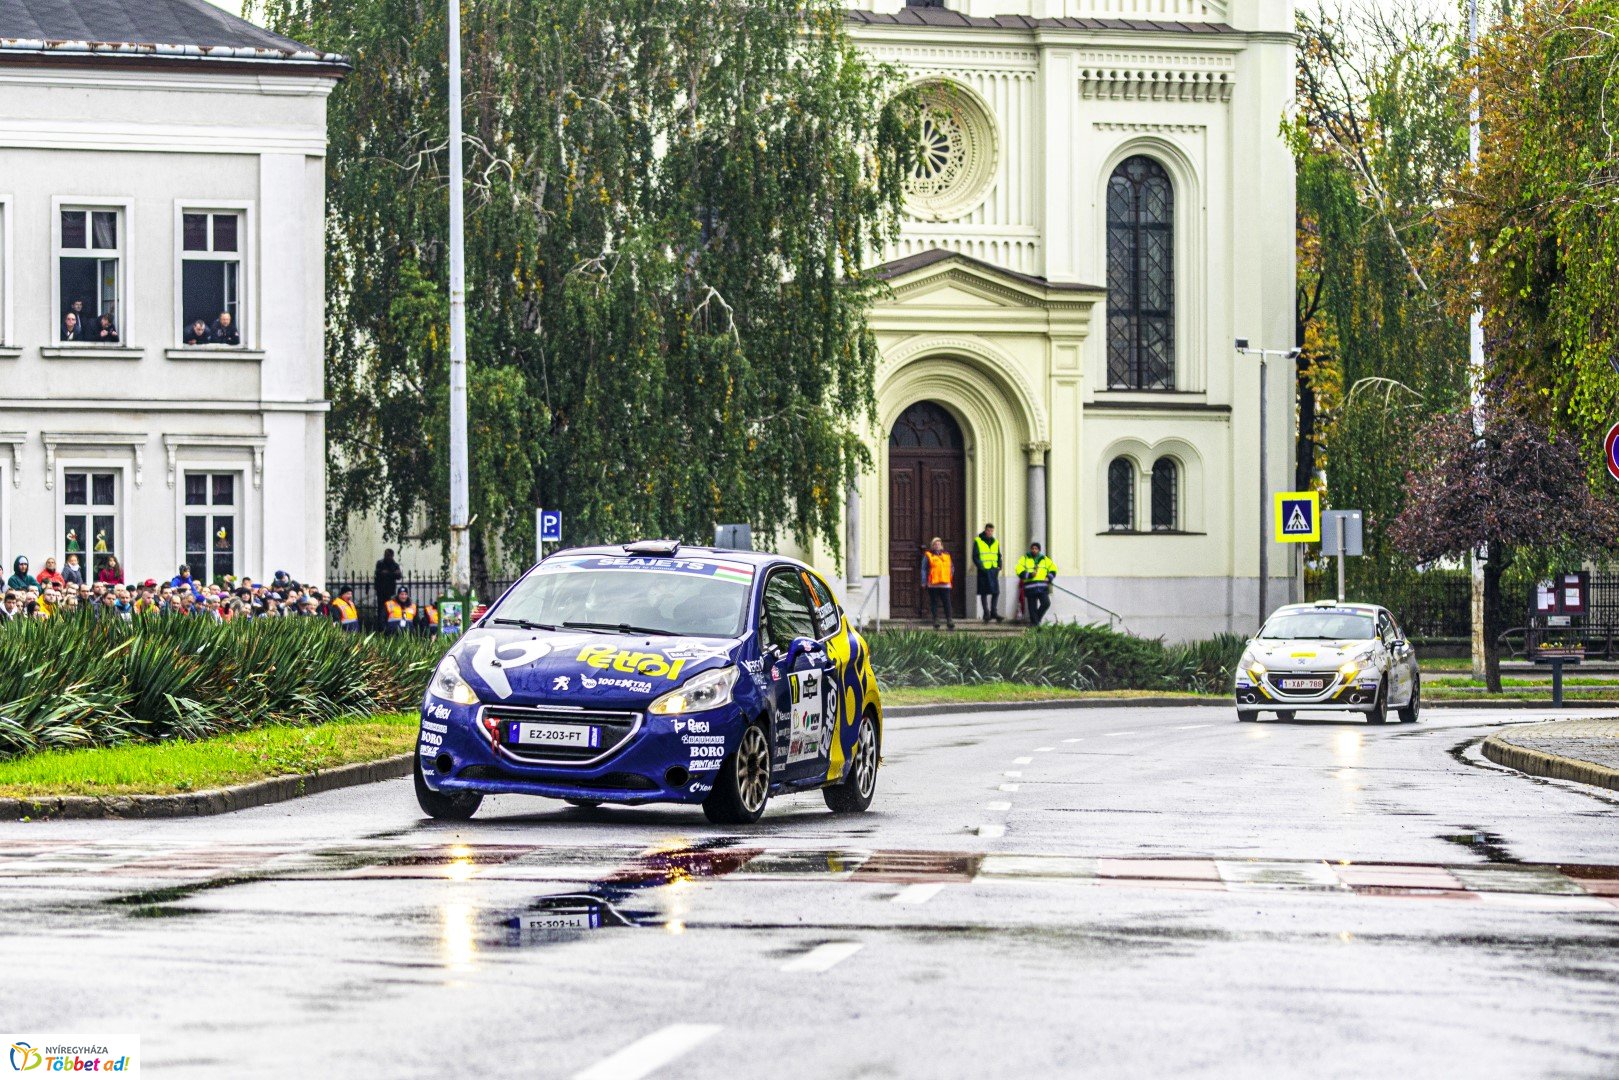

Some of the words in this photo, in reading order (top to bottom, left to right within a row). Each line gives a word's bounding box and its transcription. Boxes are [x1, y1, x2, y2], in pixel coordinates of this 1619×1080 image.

[544, 515, 557, 533] P
[598, 557, 704, 570] SEAJETS
[598, 677, 615, 686] 100
[421, 731, 443, 746] BORO
[529, 730, 581, 741] EZ-203-FT
[690, 746, 724, 757] BORO
